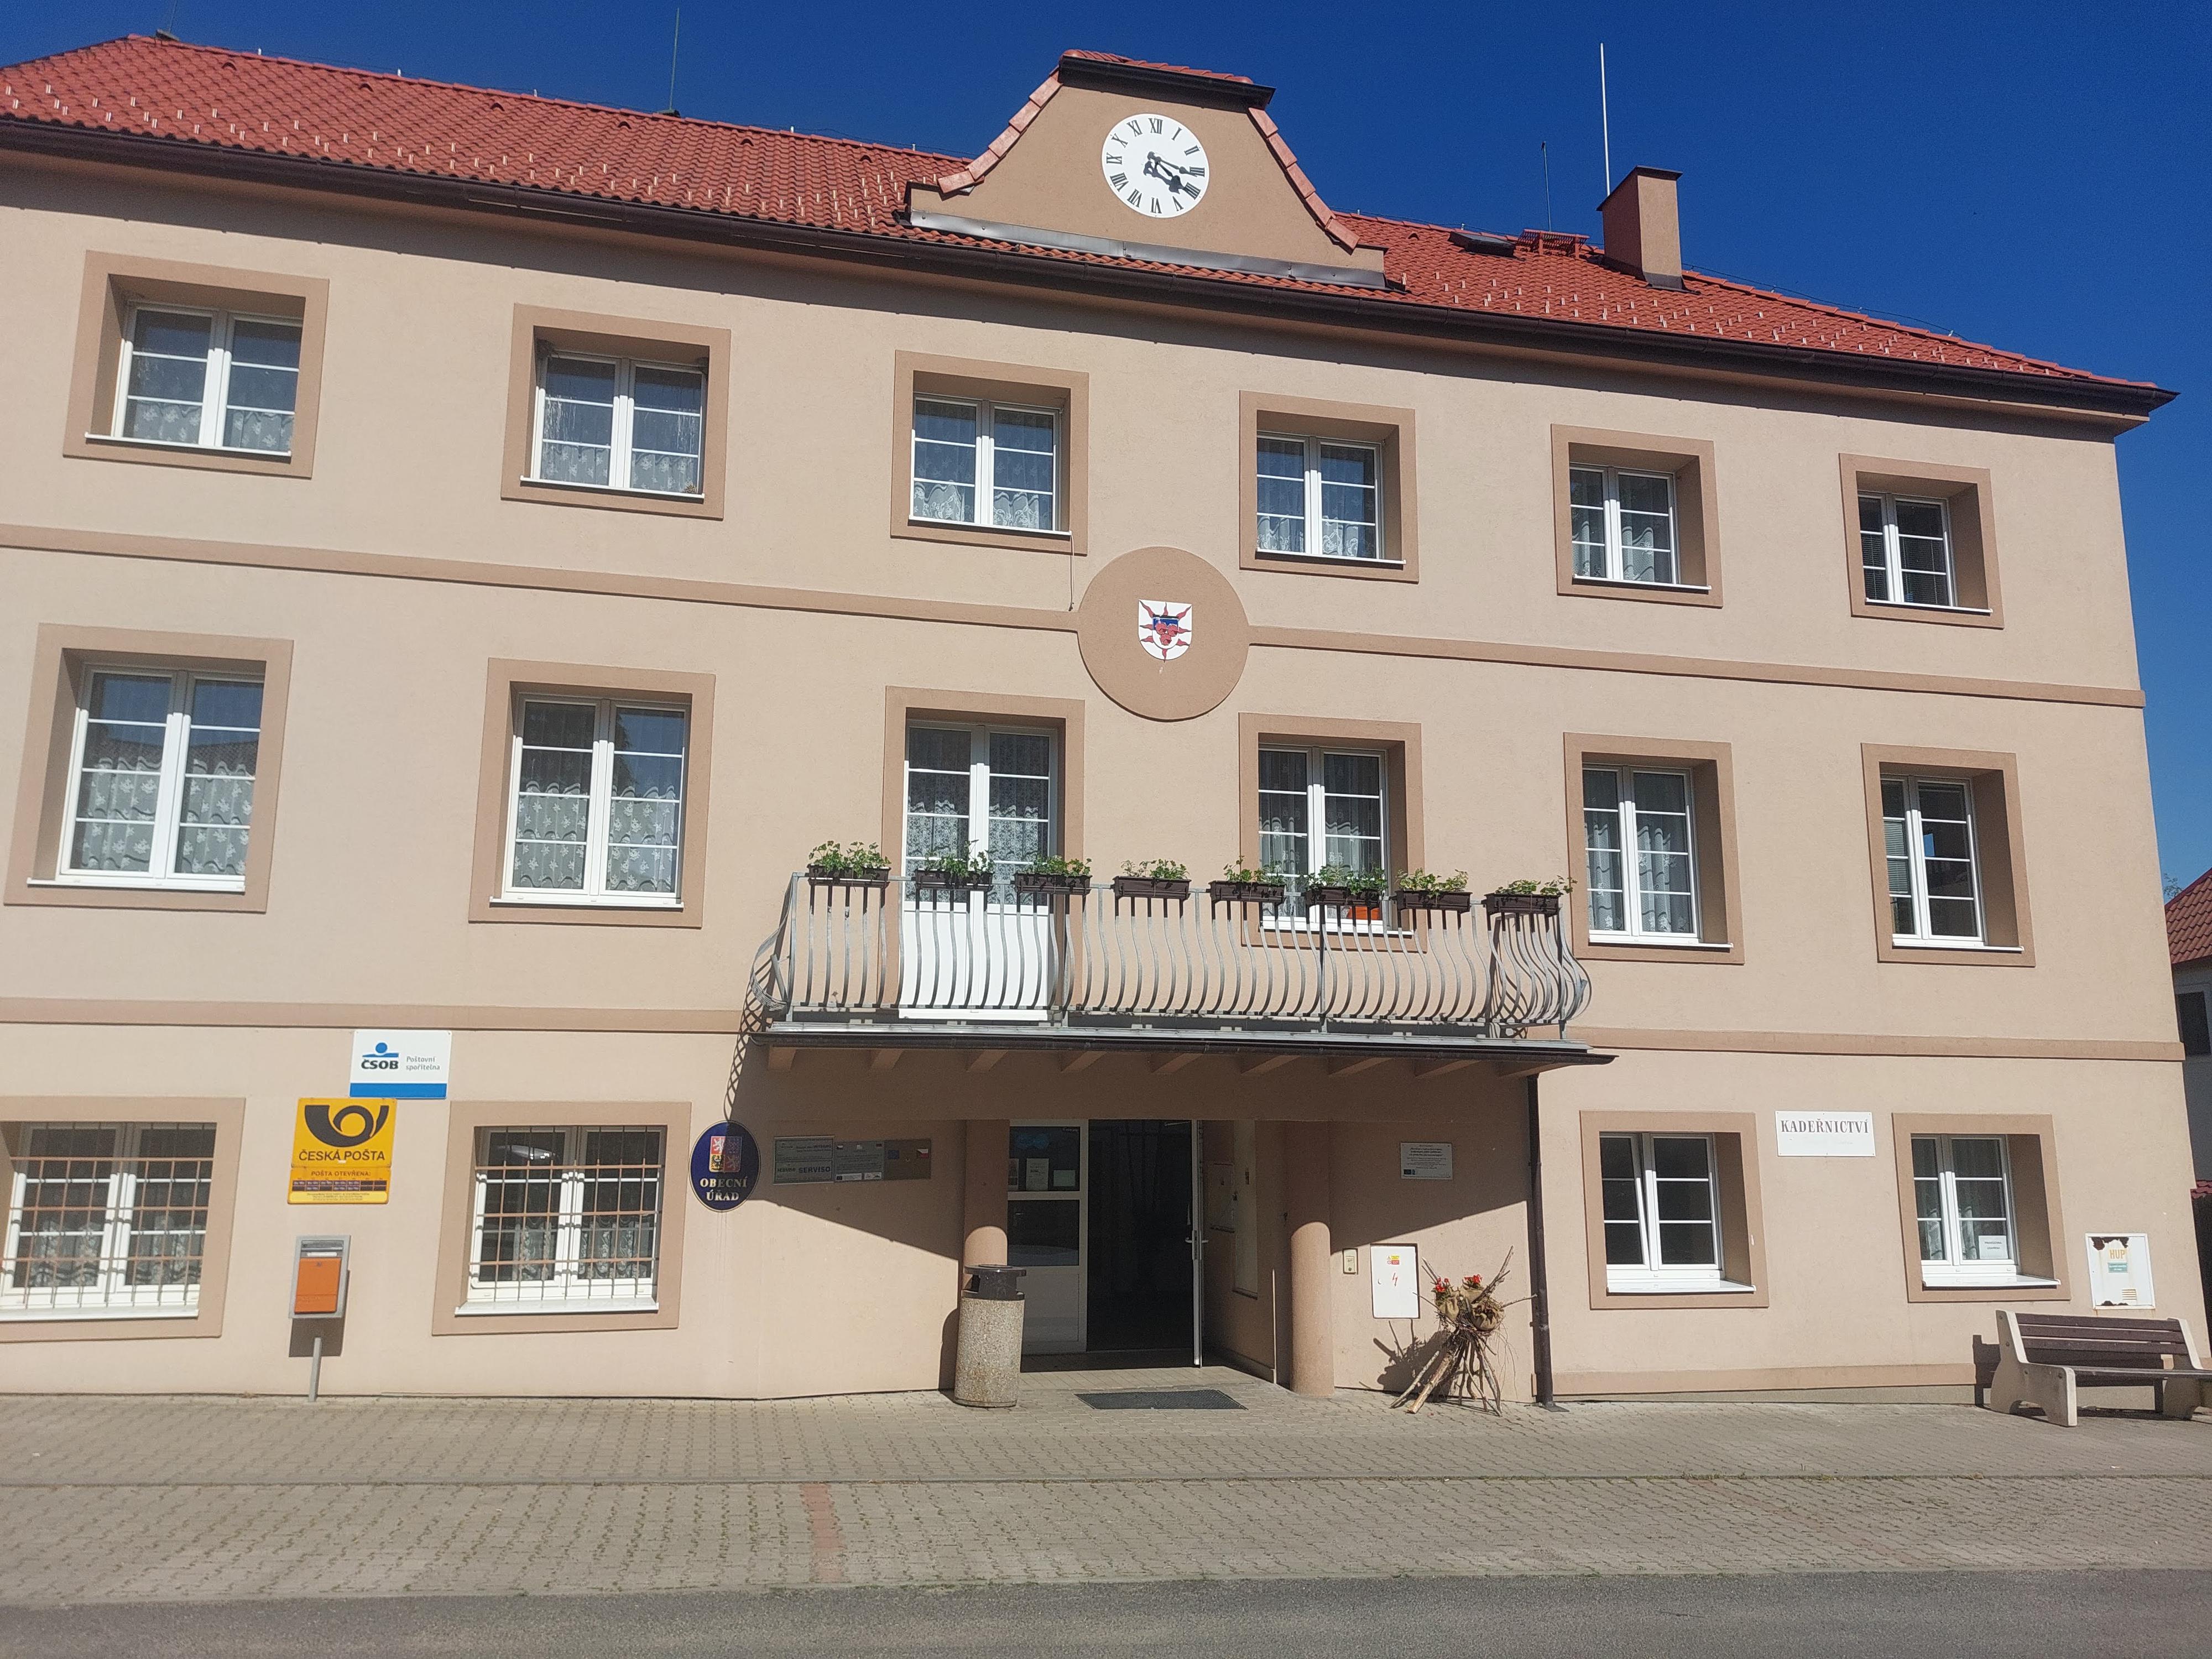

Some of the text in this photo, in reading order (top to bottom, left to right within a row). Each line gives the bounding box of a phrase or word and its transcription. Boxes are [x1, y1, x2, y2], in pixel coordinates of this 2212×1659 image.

[1126, 120, 1143, 137] XI
[1149, 118, 1163, 134] XII
[1111, 133, 1128, 148] X
[1107, 152, 1122, 164] IX
[1184, 145, 1199, 156] II
[1110, 173, 1129, 192] VIII
[1127, 189, 1142, 208] VII
[1150, 197, 1162, 213] VI
[1172, 196, 1184, 211] V
[361, 1059, 399, 1070] ČSOB
[1781, 1118, 1869, 1133] KADEŘNICTVÍ
[299, 1149, 385, 1161] ČESKÁ POŠTA
[700, 1177, 748, 1187] OBECNÍ
[706, 1189, 739, 1201] ÚŘAD
[2110, 1249, 2125, 1259] HUP
